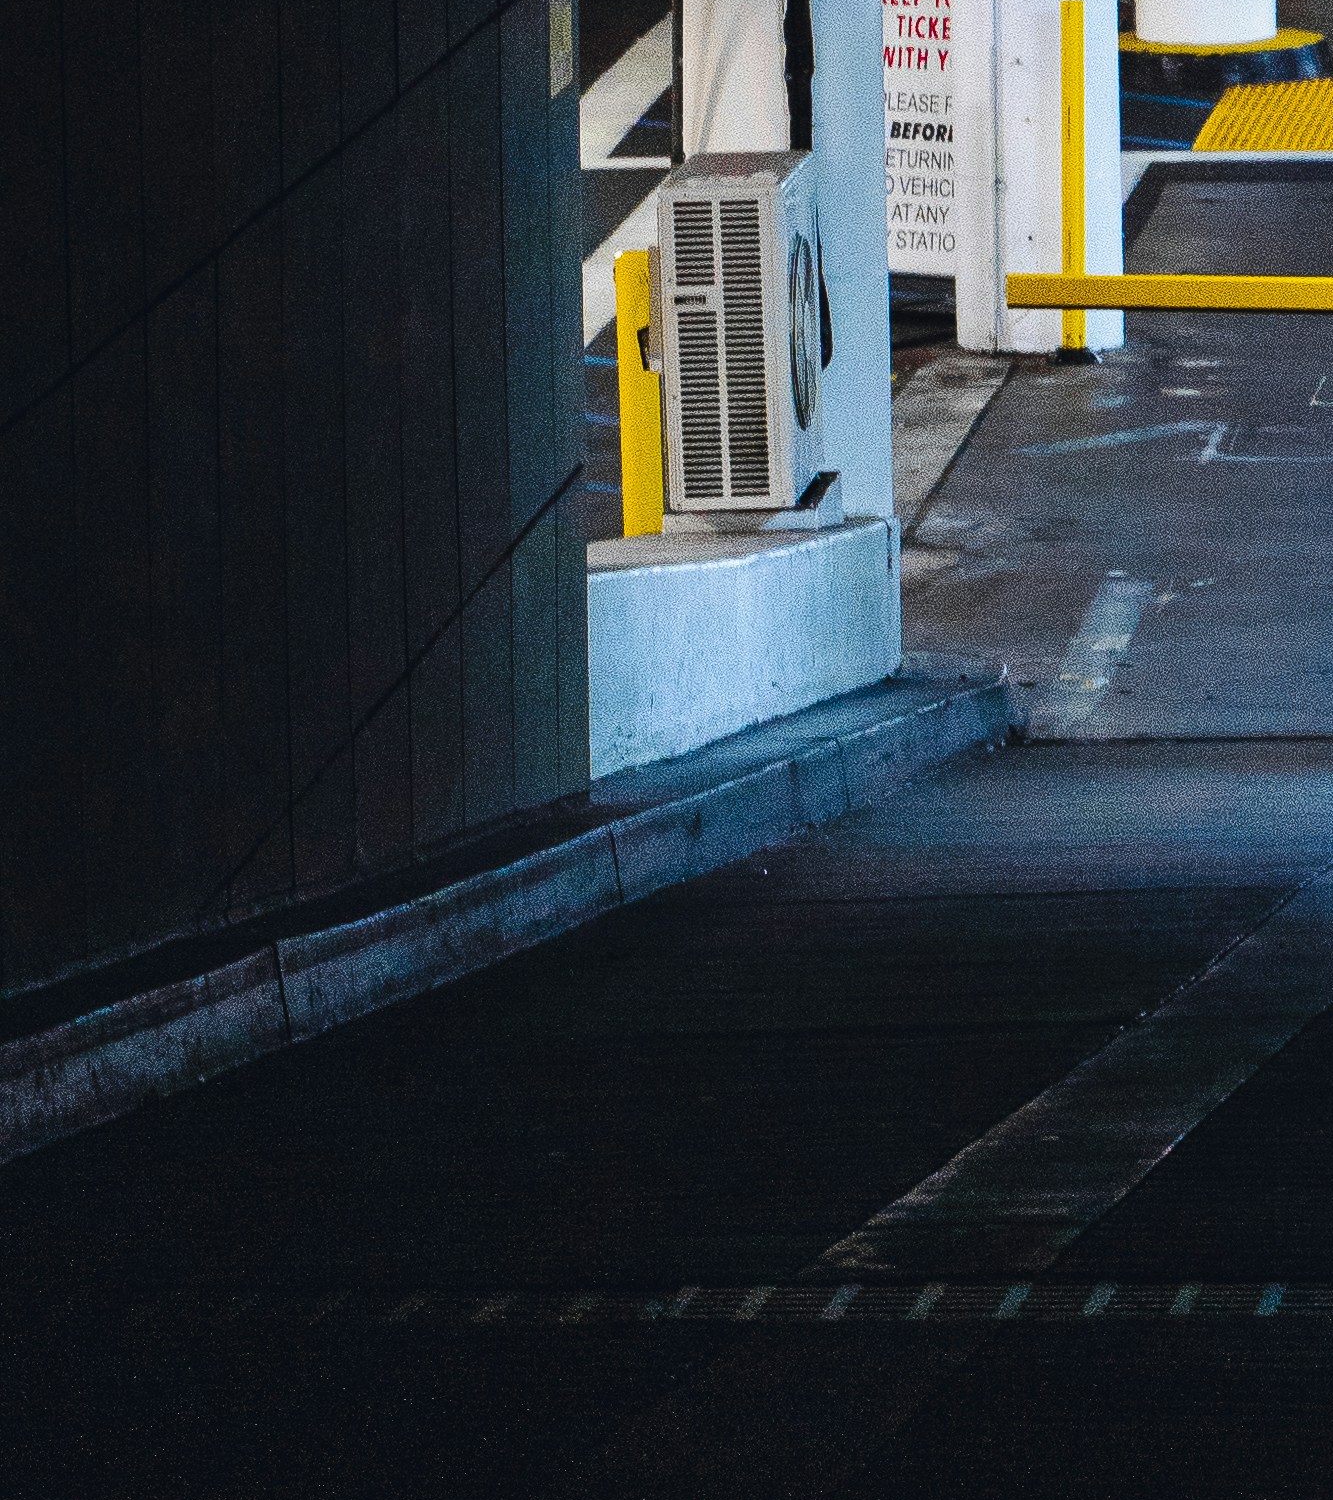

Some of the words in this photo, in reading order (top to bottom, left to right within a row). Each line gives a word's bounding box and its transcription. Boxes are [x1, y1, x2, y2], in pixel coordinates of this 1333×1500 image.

[884, 92, 940, 114] LEASE
[892, 203, 912, 223] AT
[915, 206, 949, 225] ANY
